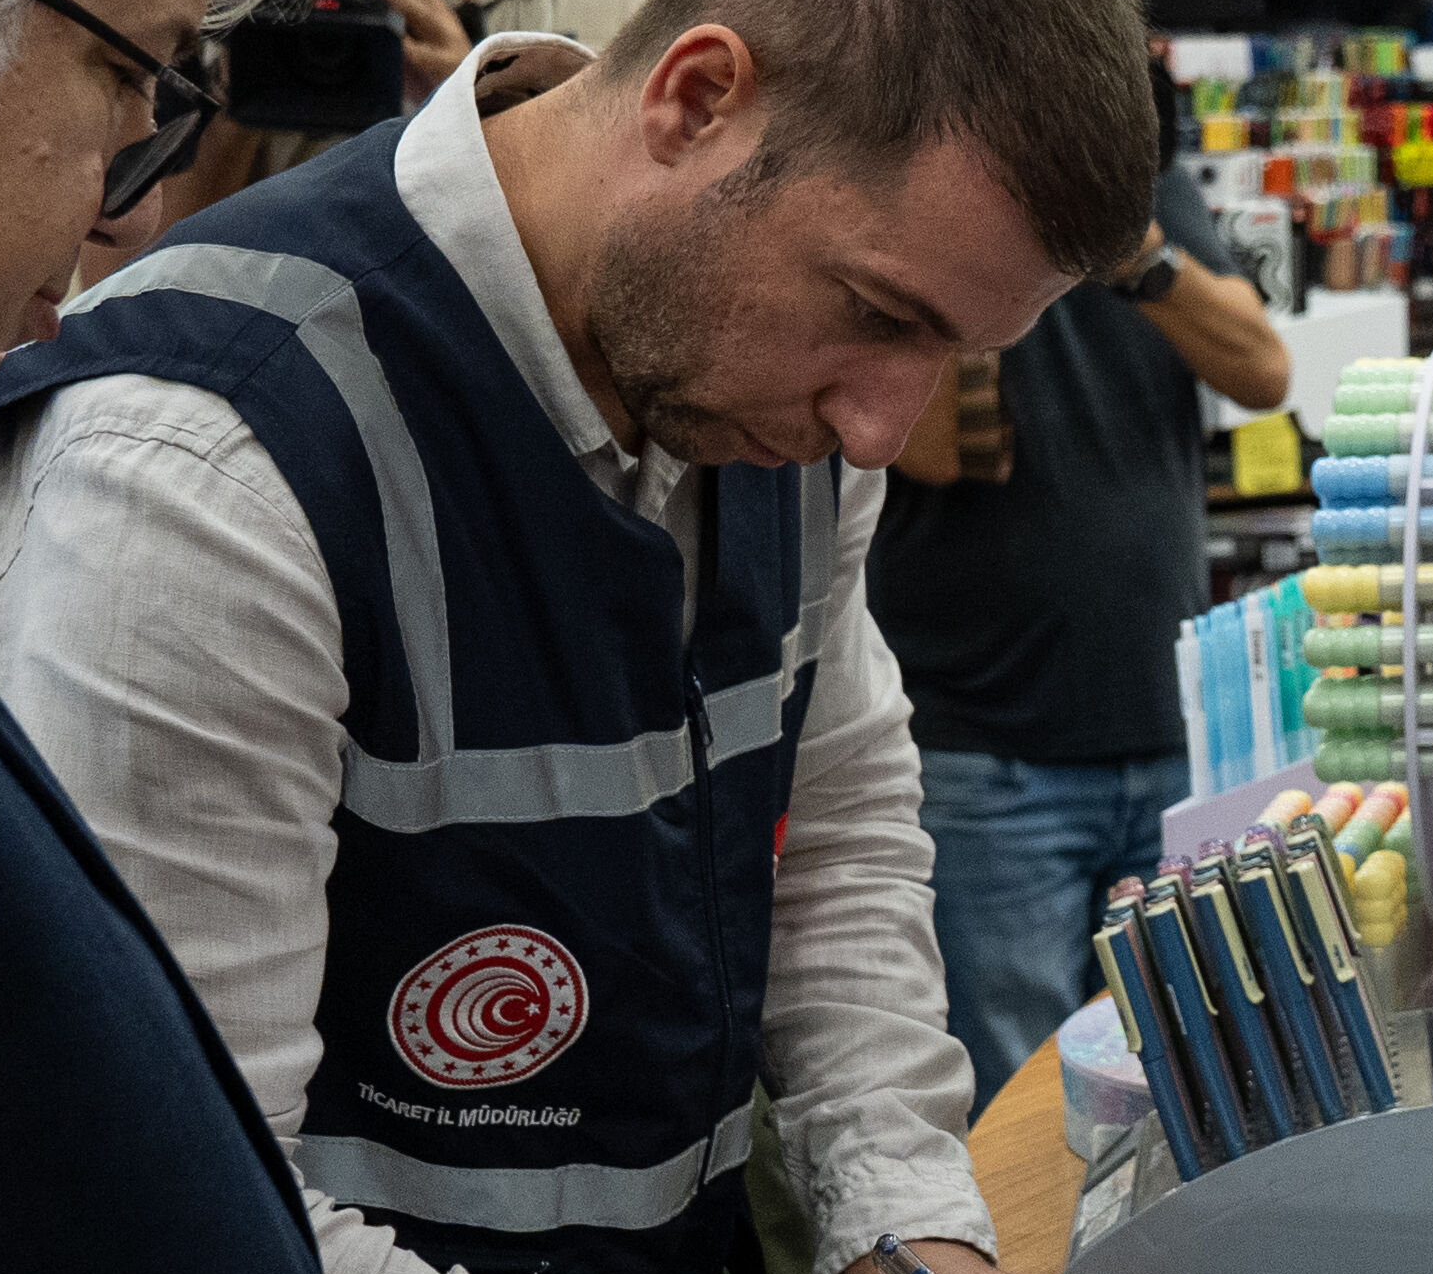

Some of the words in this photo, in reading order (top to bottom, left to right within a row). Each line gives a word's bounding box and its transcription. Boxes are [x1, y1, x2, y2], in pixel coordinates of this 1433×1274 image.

[357, 1080, 436, 1125] TİCARET
[436, 1104, 457, 1127] İL
[457, 1102, 582, 1128] MÜDÜRLÜĞÜ
